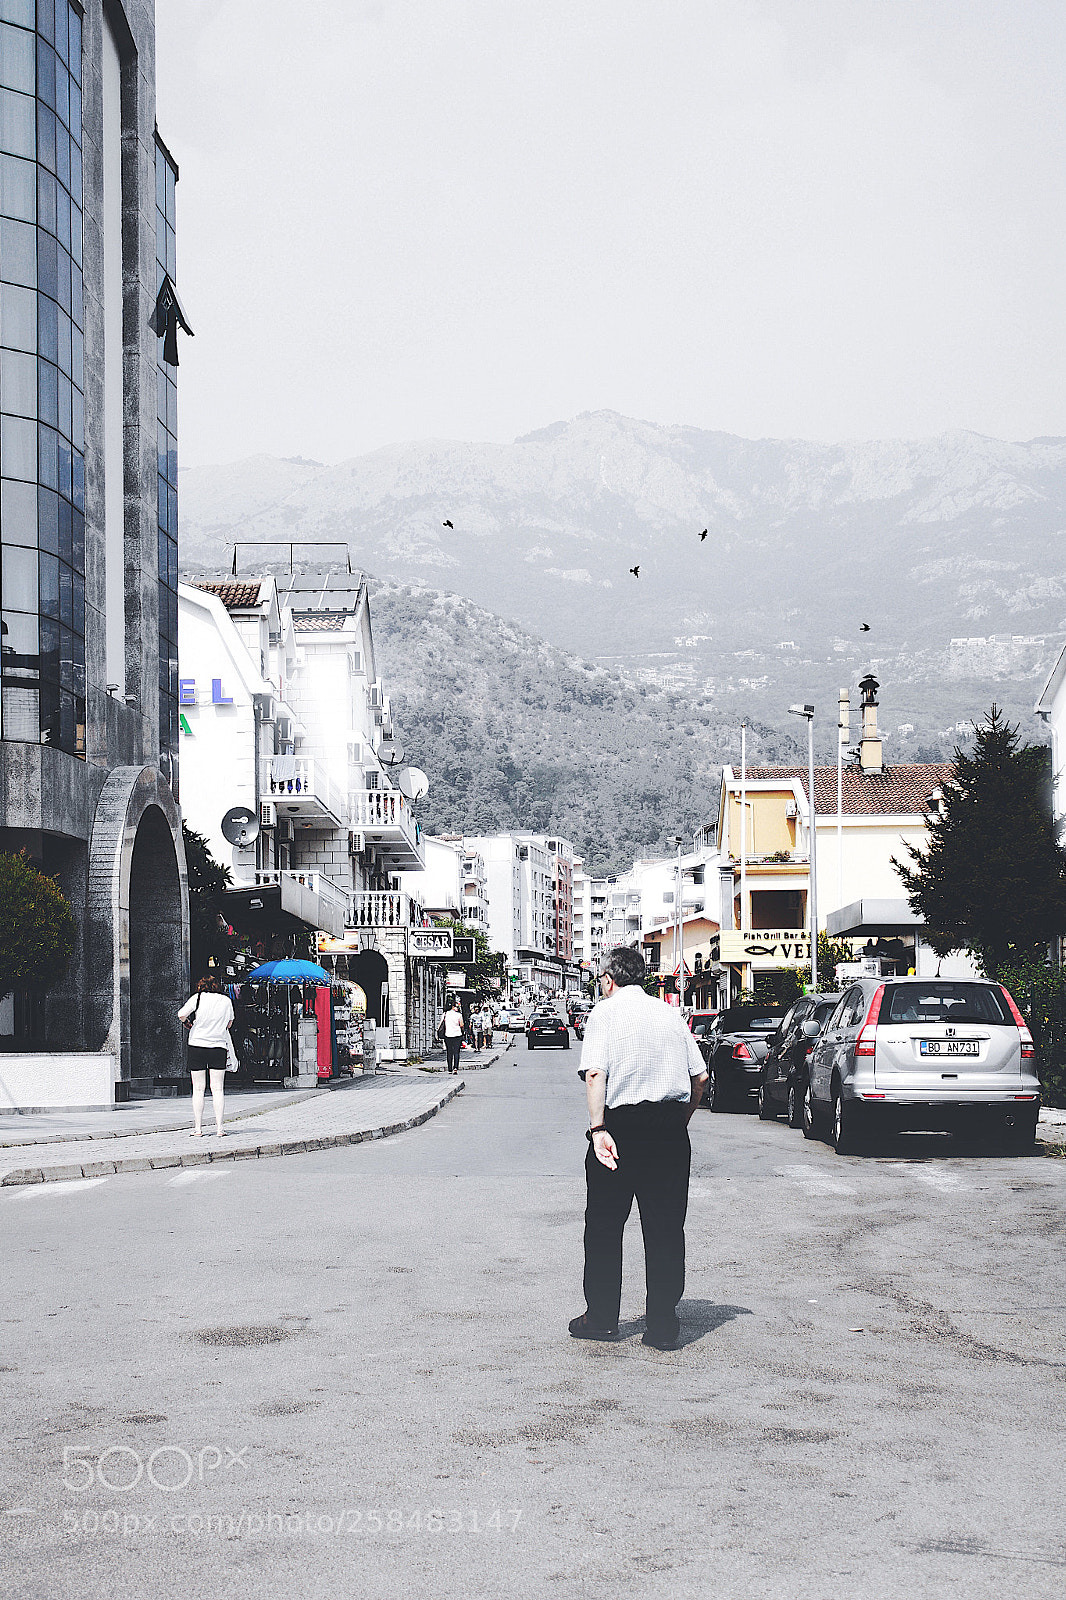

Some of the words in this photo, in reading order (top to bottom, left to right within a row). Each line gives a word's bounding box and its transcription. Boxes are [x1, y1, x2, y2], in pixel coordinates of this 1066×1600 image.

[744, 932, 762, 940] Fish
[763, 932, 781, 940] Grill
[783, 932, 799, 940] Bar
[414, 935, 449, 949] CESAR
[946, 1042, 978, 1053] AN731
